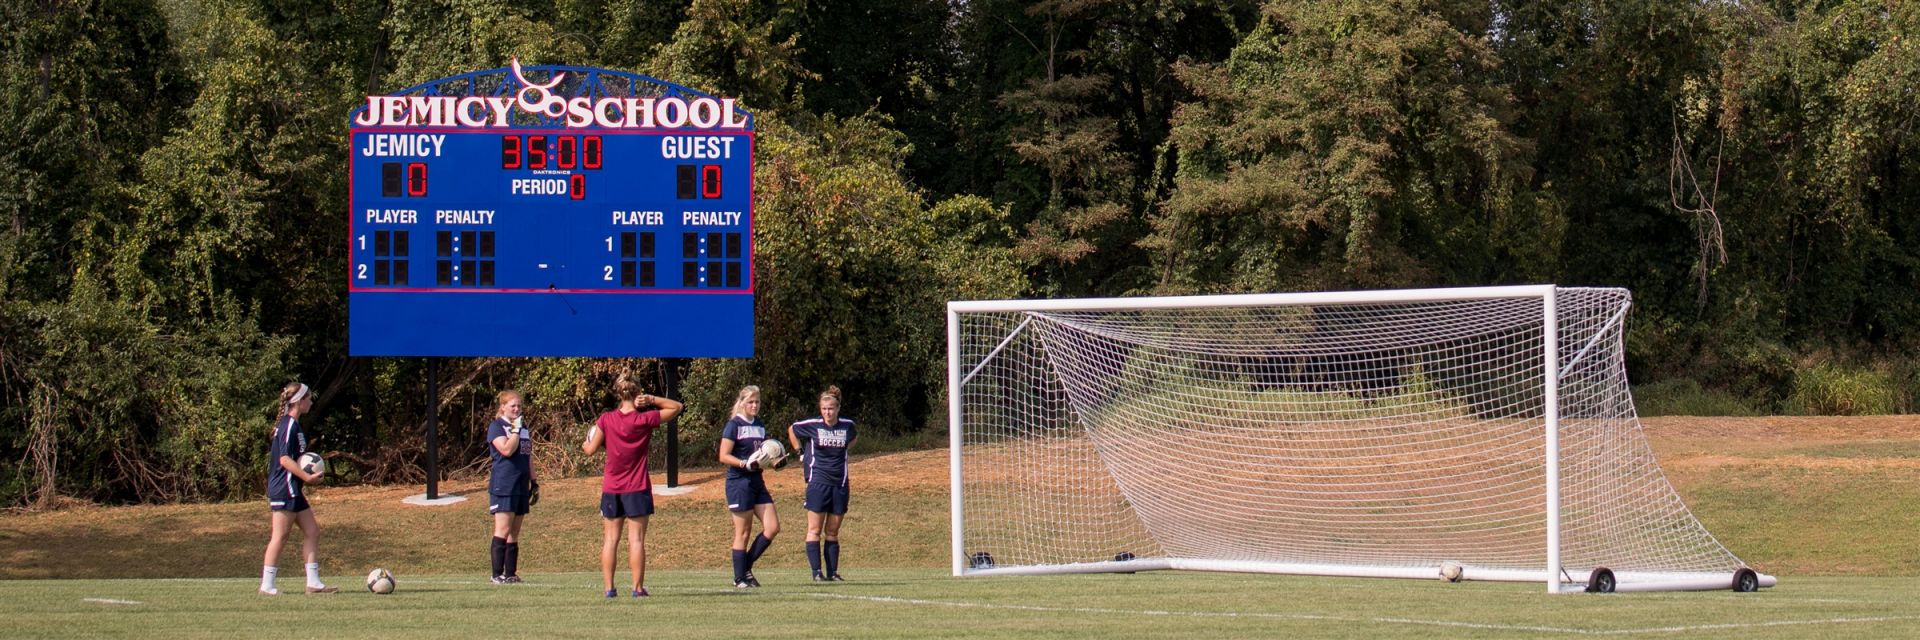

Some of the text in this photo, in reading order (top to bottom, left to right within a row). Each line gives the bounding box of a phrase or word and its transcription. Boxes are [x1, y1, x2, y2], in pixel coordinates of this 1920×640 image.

[356, 95, 748, 129] JEMICY SCHOOL
[363, 134, 446, 157] JEMICY
[503, 136, 602, 169] 35:00
[661, 136, 734, 159] GUEST
[408, 163, 427, 196] 0
[513, 174, 585, 200] PERIOD 0
[702, 165, 721, 199] 0
[366, 209, 418, 224] PLAYER
[436, 210, 495, 225] PENALTY
[612, 210, 664, 226] PLAYER
[682, 211, 741, 226] PENALTY
[358, 235, 366, 250] 1
[605, 236, 613, 252] 1
[358, 264, 367, 280] 2
[603, 266, 613, 281] 2
[819, 439, 846, 447] SOCCER
